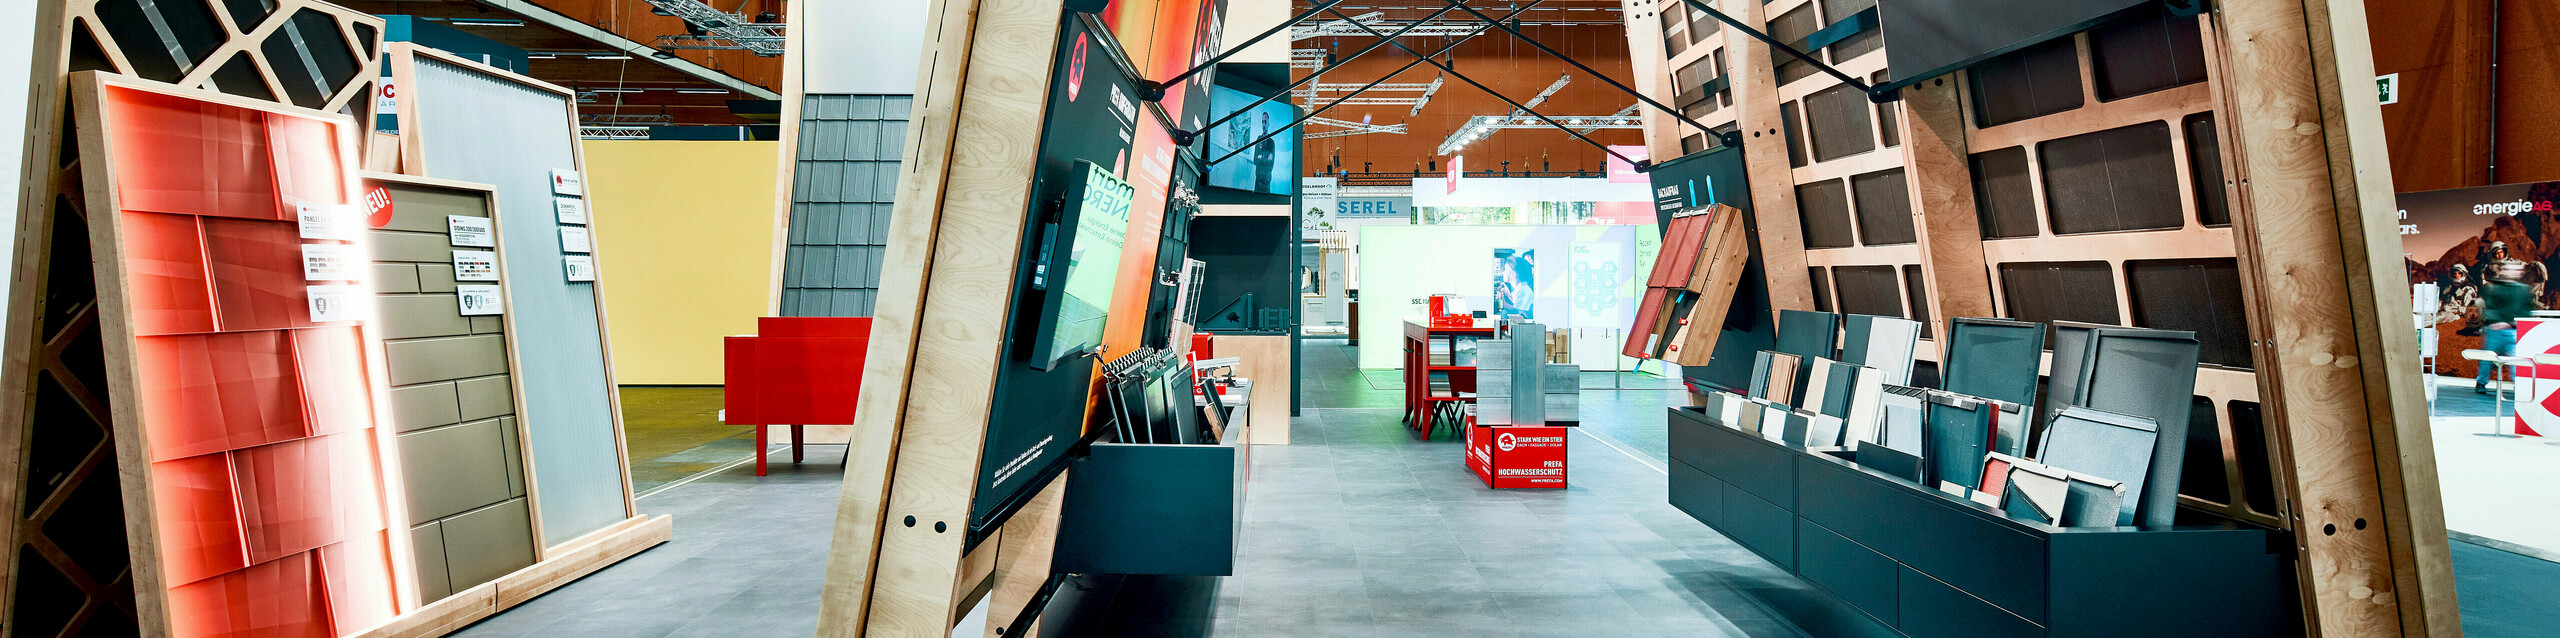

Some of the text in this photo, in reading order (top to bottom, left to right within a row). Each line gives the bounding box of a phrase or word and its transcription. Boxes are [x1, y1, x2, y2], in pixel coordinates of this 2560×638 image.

[379, 84, 395, 98] C
[1337, 201, 1397, 214] SEREL
[1544, 460, 1563, 468] PREFA
[1498, 468, 1563, 476] HOCHWASSERSCHUTZ
